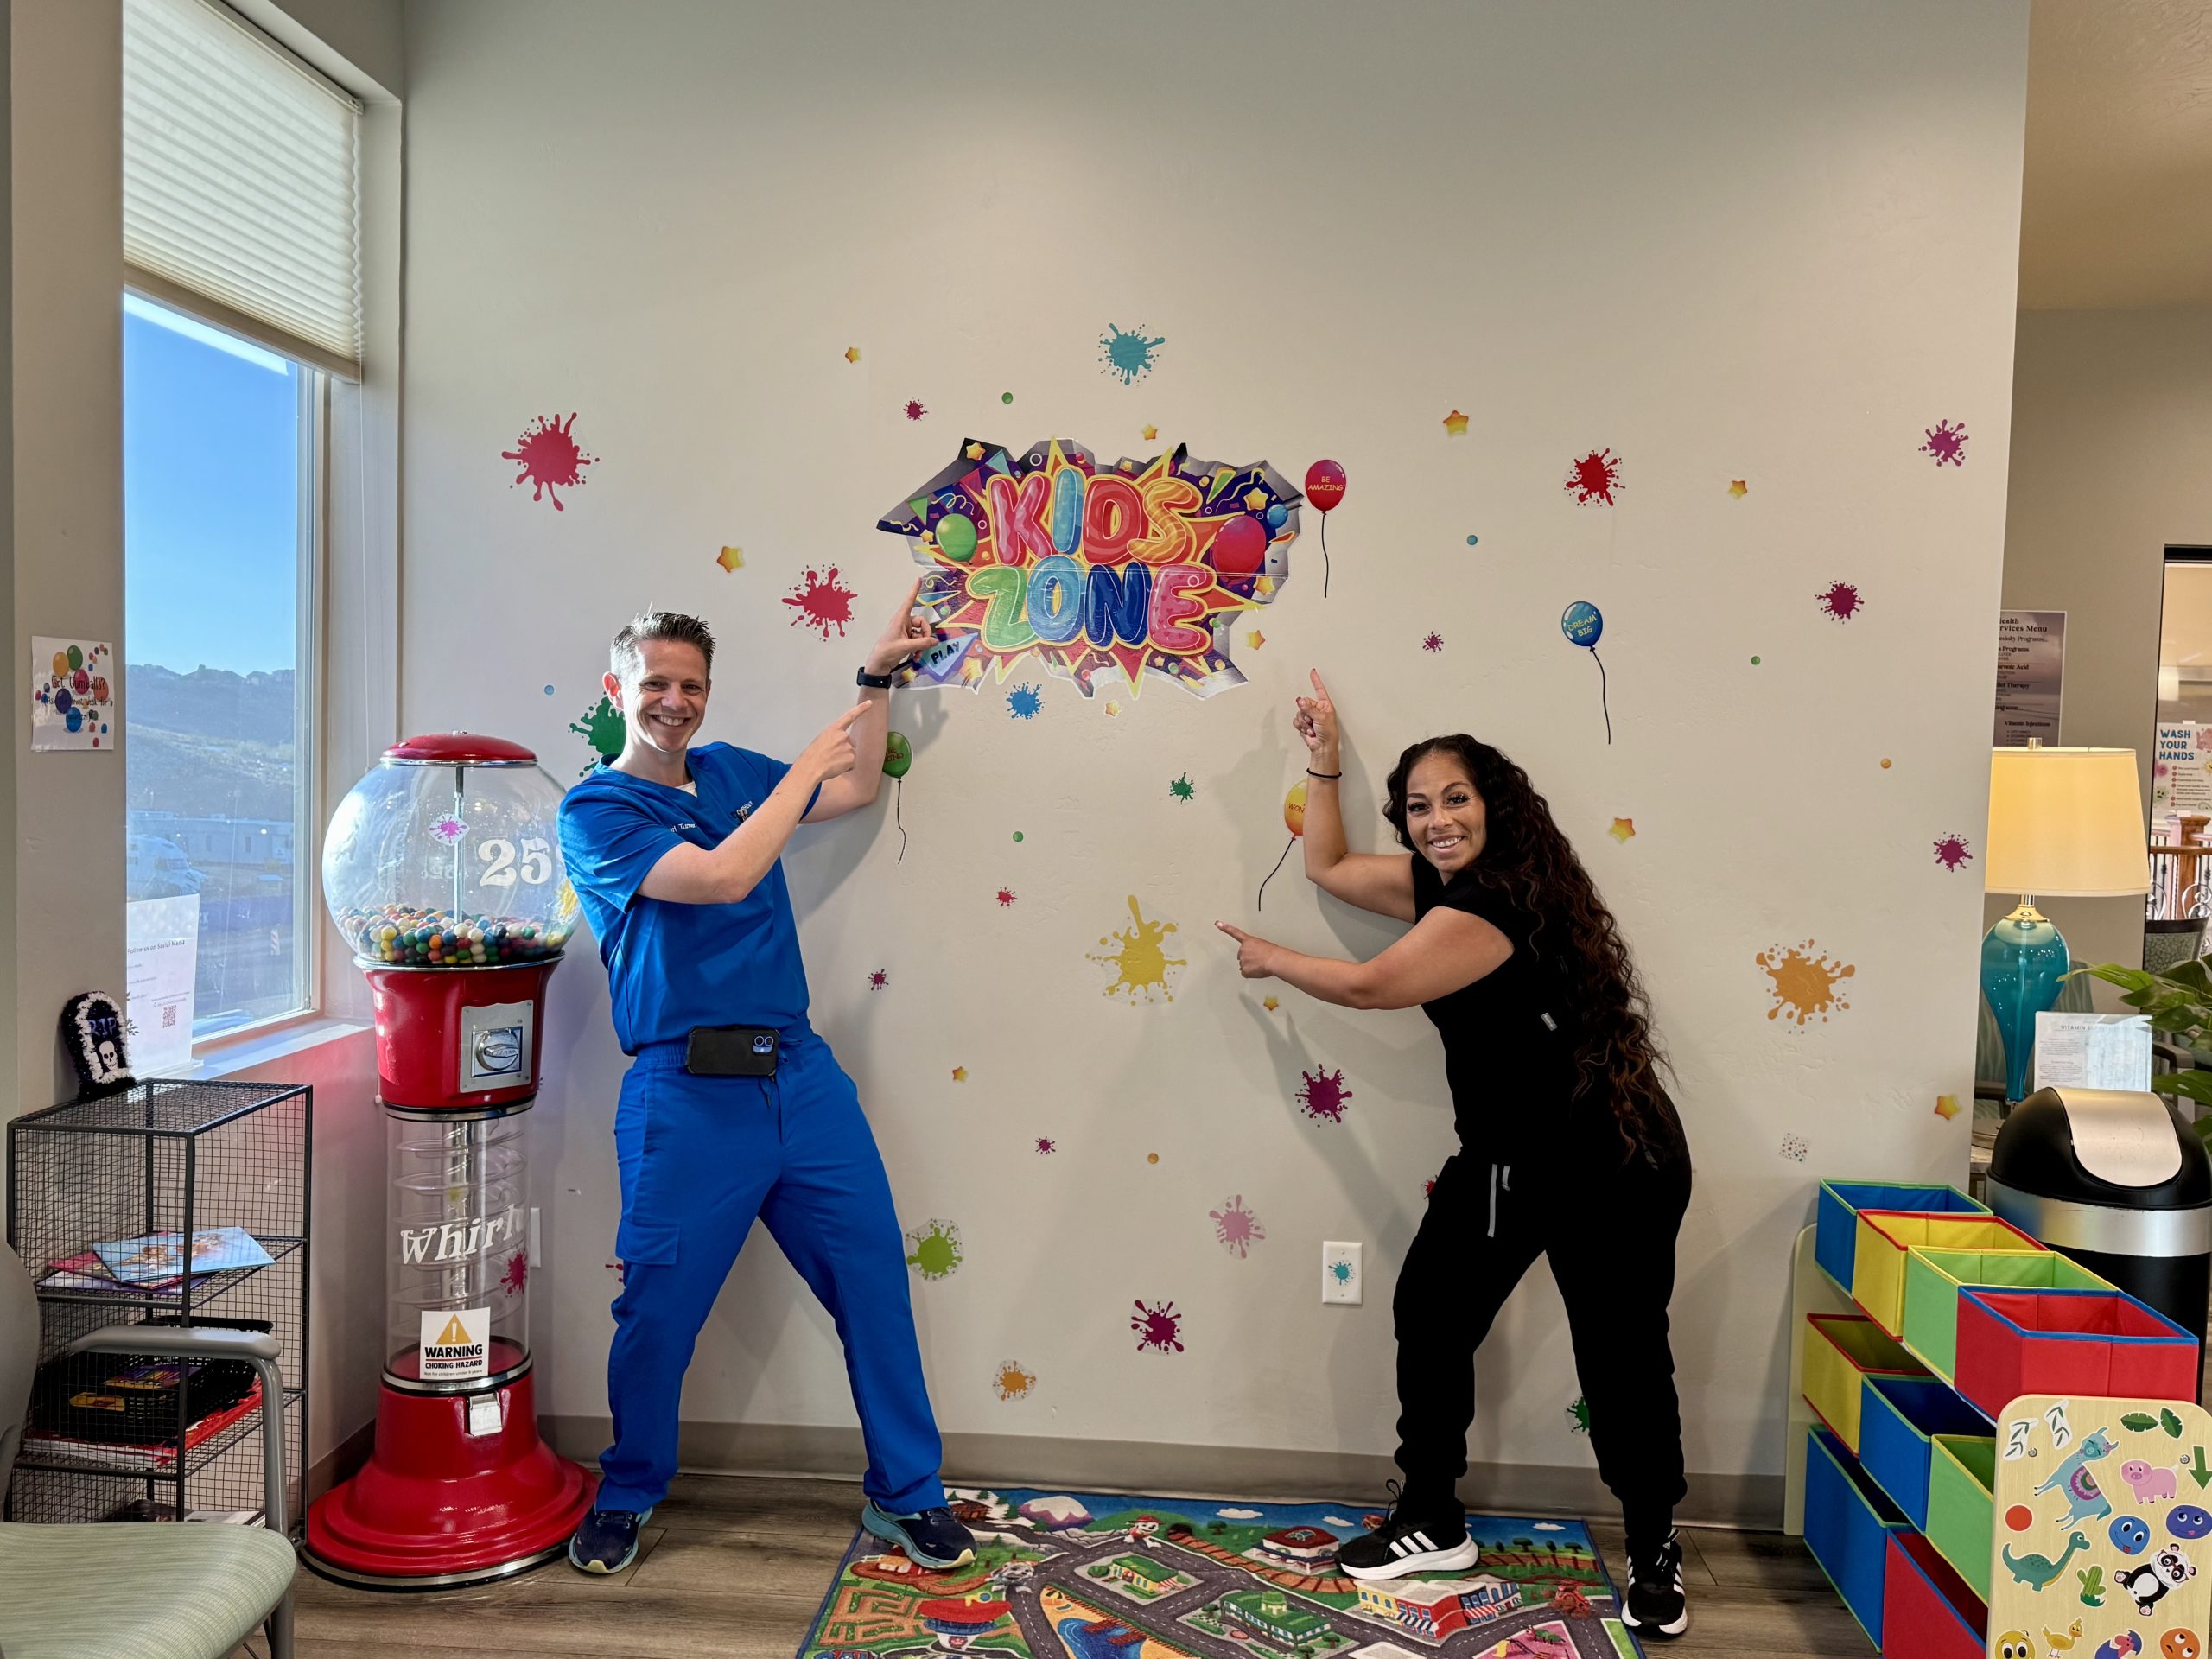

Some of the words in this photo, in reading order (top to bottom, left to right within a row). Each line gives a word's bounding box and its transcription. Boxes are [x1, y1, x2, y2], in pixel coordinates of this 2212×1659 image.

[989, 467, 1202, 566] KIDS
[969, 556, 1212, 652] ZONE
[1567, 614, 1598, 632] DREAM
[1577, 626, 1593, 637] BIG
[931, 641, 959, 664] PLAY
[52, 676, 66, 690] Got
[69, 676, 105, 690] Gumballs?
[2160, 729, 2190, 739] WASH
[2160, 741, 2187, 749] YOUR
[2159, 751, 2194, 760] HANDS
[1288, 803, 1306, 813] WON
[479, 836, 563, 887] 25
[157, 941, 170, 950] Social
[88, 1017, 117, 1037] RIP
[424, 1344, 482, 1358] WARNING
[455, 1360, 482, 1369] HAZARD
